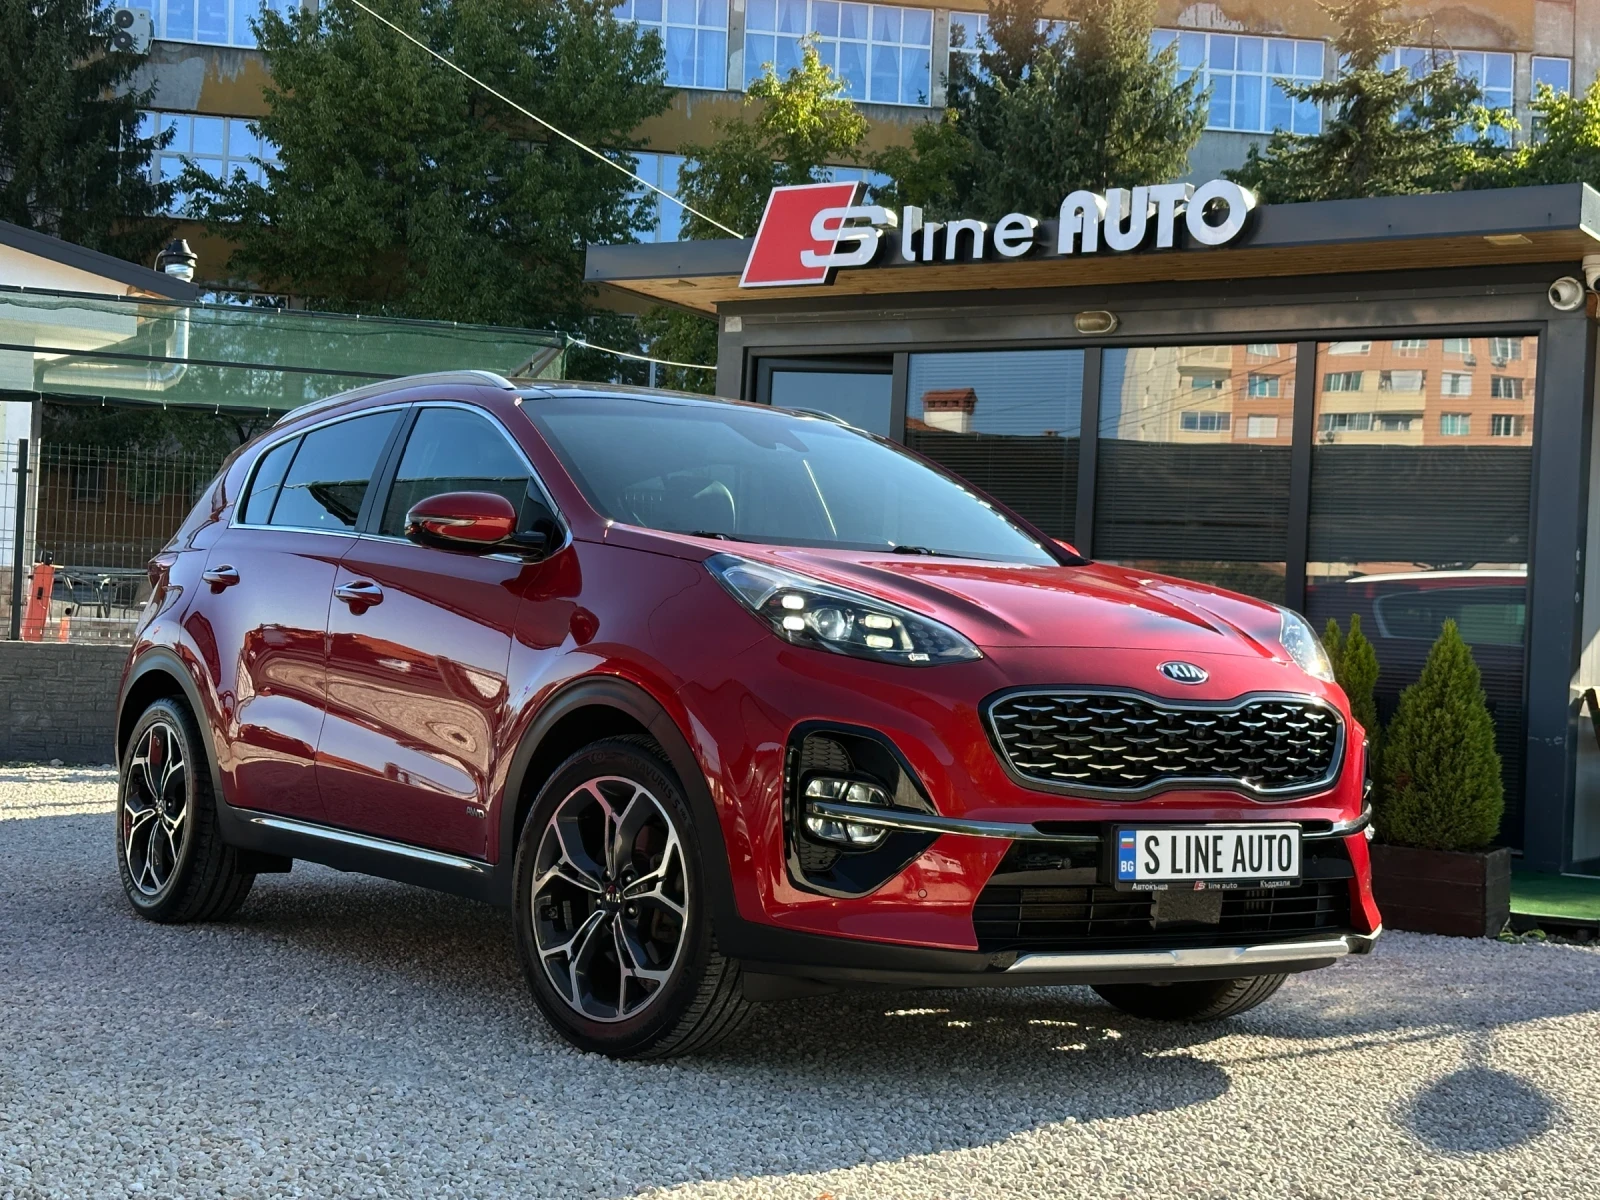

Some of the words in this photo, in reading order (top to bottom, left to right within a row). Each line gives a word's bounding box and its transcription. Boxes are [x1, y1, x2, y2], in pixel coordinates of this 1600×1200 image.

[800, 205, 892, 268] S
[901, 205, 1036, 261] line
[1057, 179, 1252, 255] AUTO
[1166, 665, 1203, 678] KIA
[627, 755, 674, 799] BRAVURIS
[466, 806, 485, 818] AWD
[1144, 835, 1160, 875] S
[1170, 835, 1223, 874] LINE
[1231, 834, 1292, 873] AUTO
[1121, 861, 1134, 872] BG
[1131, 882, 1168, 891] Автокъща
[1260, 880, 1291, 888] Кърджали
[605, 892, 621, 903] KIA
